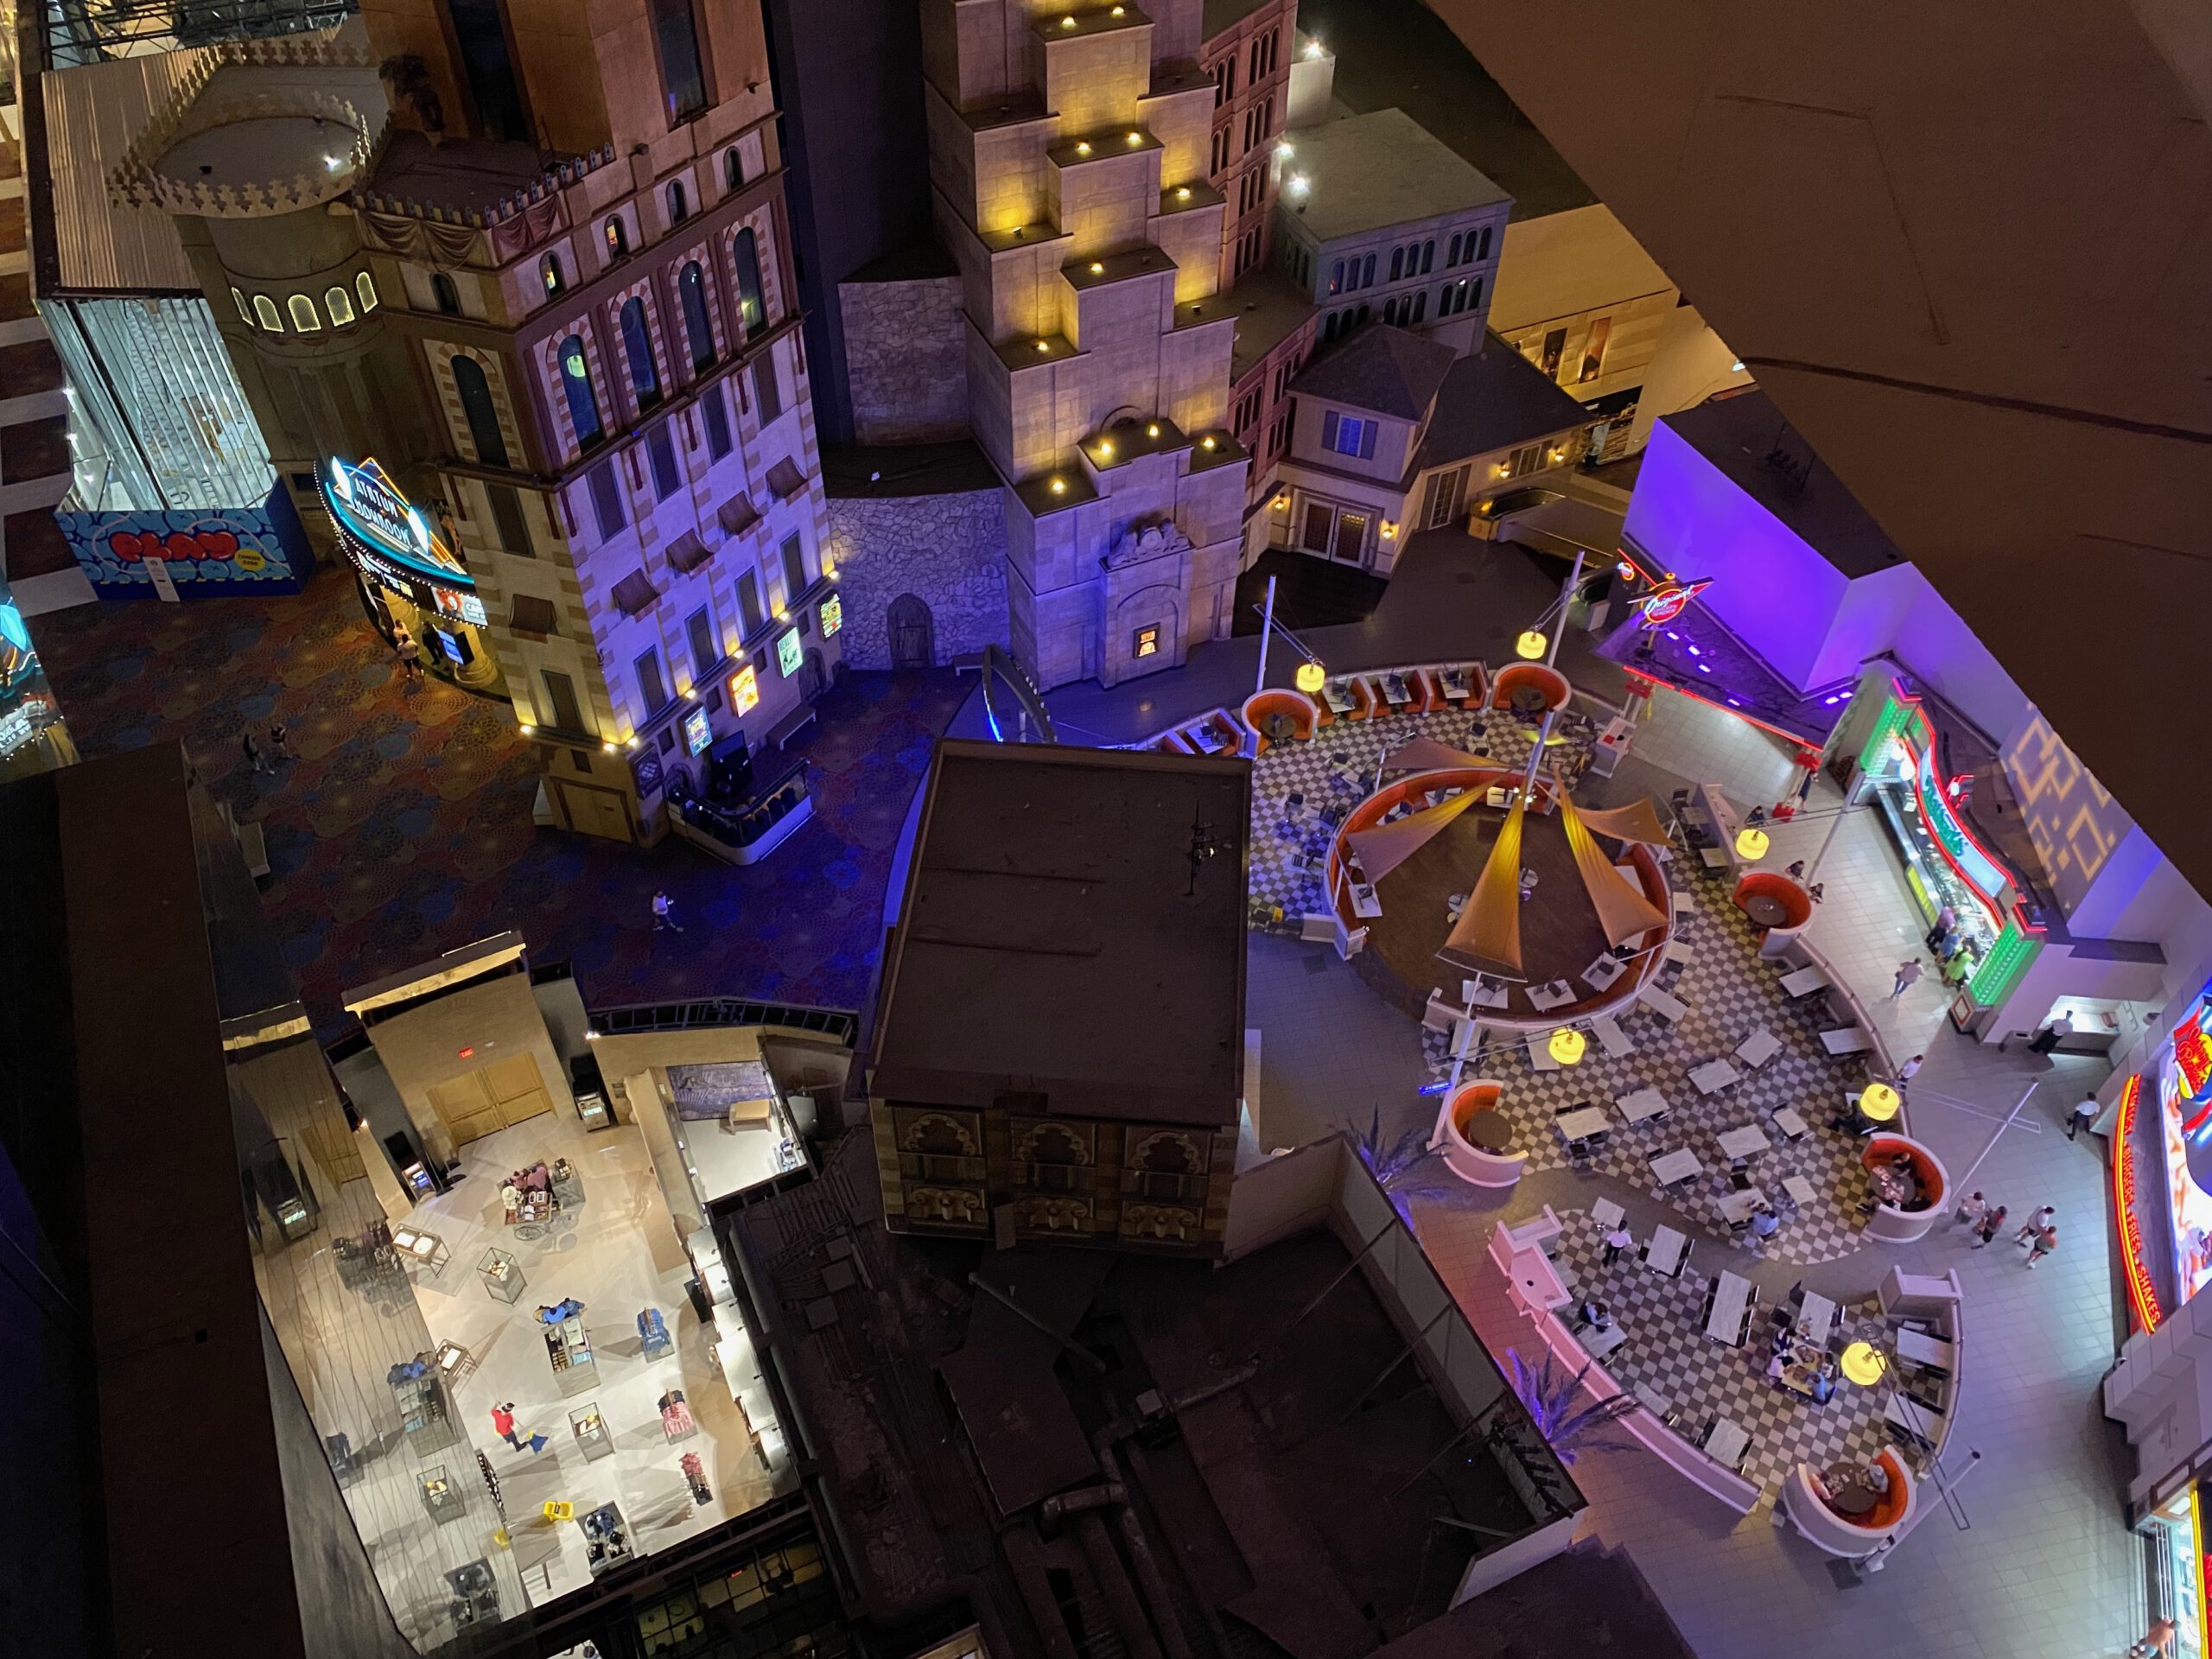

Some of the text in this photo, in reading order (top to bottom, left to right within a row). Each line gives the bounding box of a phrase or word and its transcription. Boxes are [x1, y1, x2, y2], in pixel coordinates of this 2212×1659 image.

[355, 478, 398, 518] ATRIUM
[347, 499, 412, 547] SHOWROOM
[110, 531, 238, 563] PLAY
[1644, 584, 1694, 615] Original
[2177, 1041, 2202, 1094] Rockets
[2189, 1026, 2210, 1070] Johnny
[2123, 1147, 2133, 1206] BURGERS
[2126, 1213, 2140, 1253] FRIES
[2137, 1266, 2160, 1324] SHAKES
